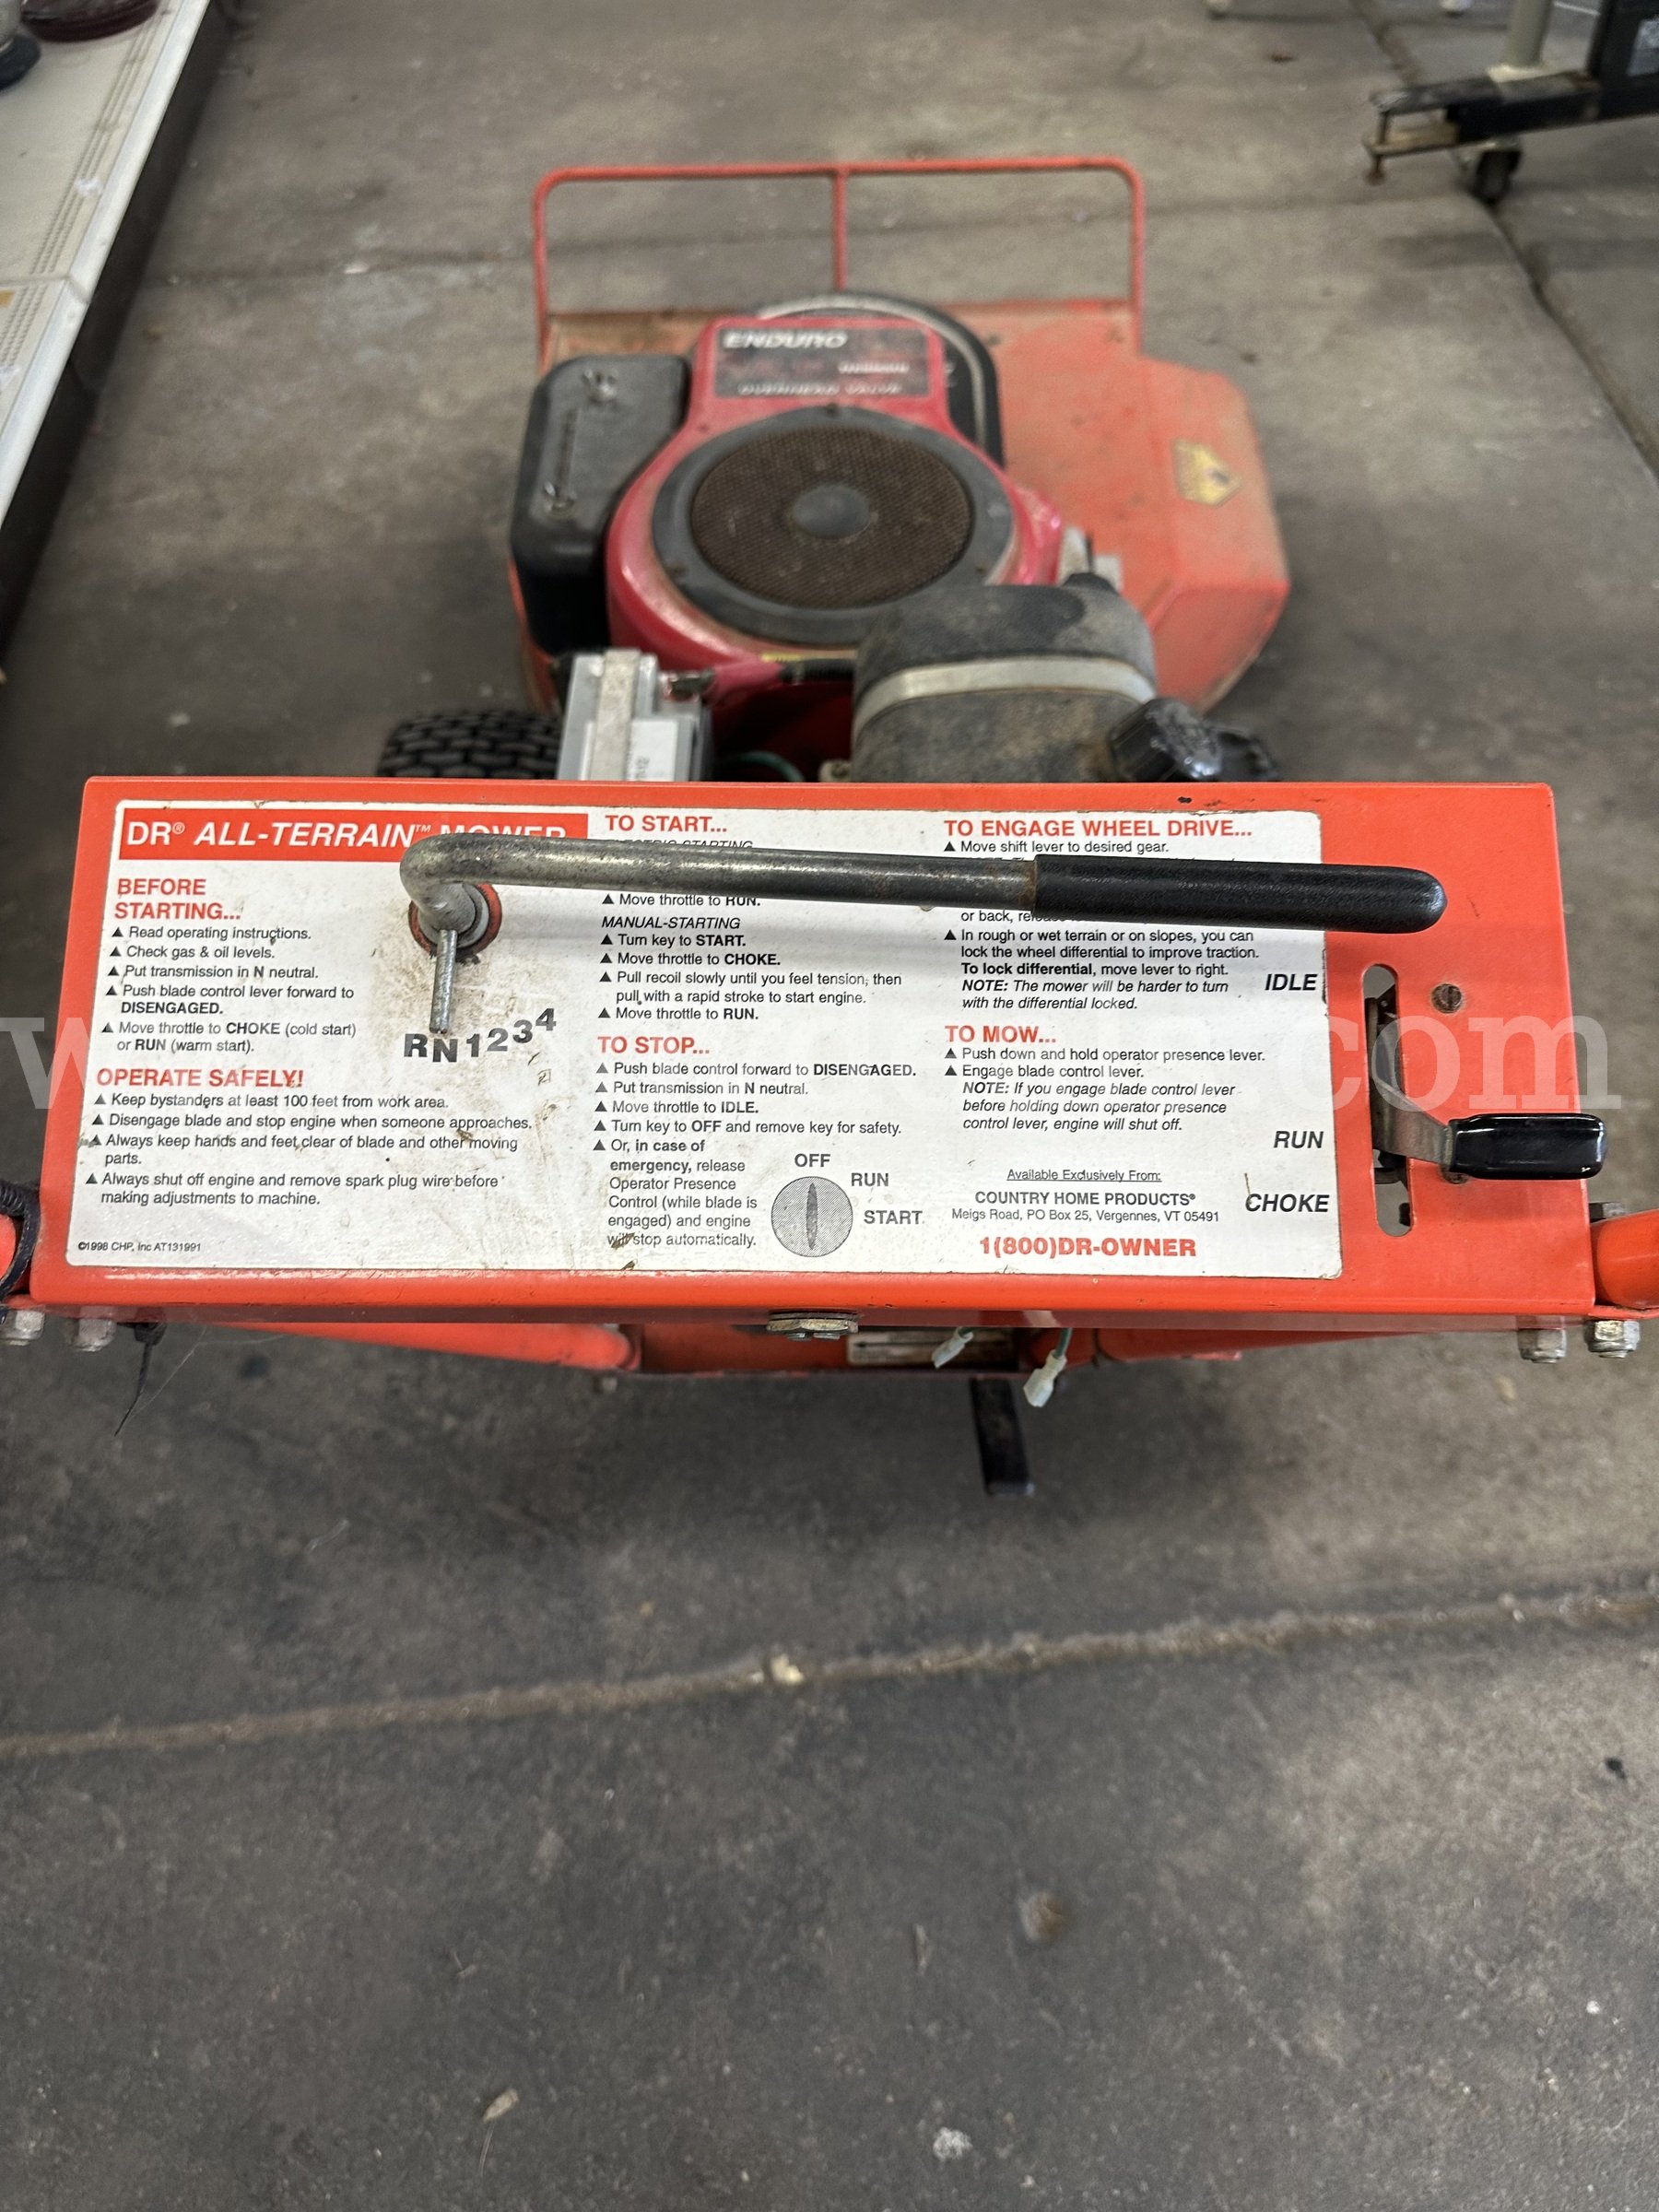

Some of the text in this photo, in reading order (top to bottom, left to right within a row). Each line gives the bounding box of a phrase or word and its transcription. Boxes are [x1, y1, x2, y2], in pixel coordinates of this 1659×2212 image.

[604, 814, 728, 833] TO START...
[943, 818, 1253, 838] TO ENGAGE WHEEL DRIVE...
[960, 840, 1170, 855] Move shift lever to desired gear.
[116, 877, 207, 899] BEFORE
[619, 892, 761, 907] Move throttle to RUN.
[113, 900, 241, 921] STARTING...
[601, 915, 741, 930] MANUAL-STARTING
[128, 925, 312, 942] Read operating instructions.
[617, 933, 747, 950] Turn key to START.
[126, 945, 275, 961] Check gas & oil levels.
[618, 951, 782, 966] Move throttle to CHOKE.
[960, 945, 1260, 962] lock the wheel differential to improve traction.
[960, 961, 1230, 979] To lock differential, move lever to right.
[617, 970, 641, 983] Pull
[645, 971, 682, 984] recoil
[685, 971, 727, 988] slowly
[730, 971, 758, 984] until
[760, 974, 785, 988] you
[788, 971, 814, 985] feel
[872, 972, 902, 986] then
[1264, 972, 1319, 992] IDLE
[123, 983, 355, 999] Push blade control lever forward to
[120, 1001, 224, 1015] DISENGAGED.
[961, 995, 1138, 1010] with the differential locked.
[615, 1006, 759, 1020] Move throttle to RUN.
[944, 1024, 1056, 1044] TO MOW...
[596, 1035, 711, 1055] TO STOP...
[962, 1046, 1266, 1065] Push down and hold operator presence lever.
[96, 1065, 304, 1089] OPERATE SAFELY!
[613, 1061, 917, 1077] Push blade control forward to DISENGAGED.
[962, 1064, 1145, 1080] Engage blade control lever.
[109, 1112, 532, 1134] Disengage blade and stop engine when someone approaches.
[610, 1118, 902, 1137] Turn key to OFF and remove key for safety.
[962, 1116, 1182, 1134] control lever, engine will shut off.
[1272, 1130, 1324, 1149] RUN
[794, 1152, 831, 1168] OFF
[609, 1176, 737, 1192] Operator Presence
[851, 1171, 889, 1187] RUN
[1006, 1169, 1162, 1182] Available Exclusively From:
[100, 1190, 321, 1207] making adjustments to machine.
[974, 1191, 1050, 1205] COUNTRY
[1053, 1192, 1100, 1206] HOME
[1244, 1193, 1331, 1213] CHOKE
[863, 1209, 922, 1225] START
[951, 1207, 1219, 1224] Meigs Road, PO Box 25, Vergennes, VT 05491
[979, 1236, 1197, 1260] 1(800)DR-OWNER
